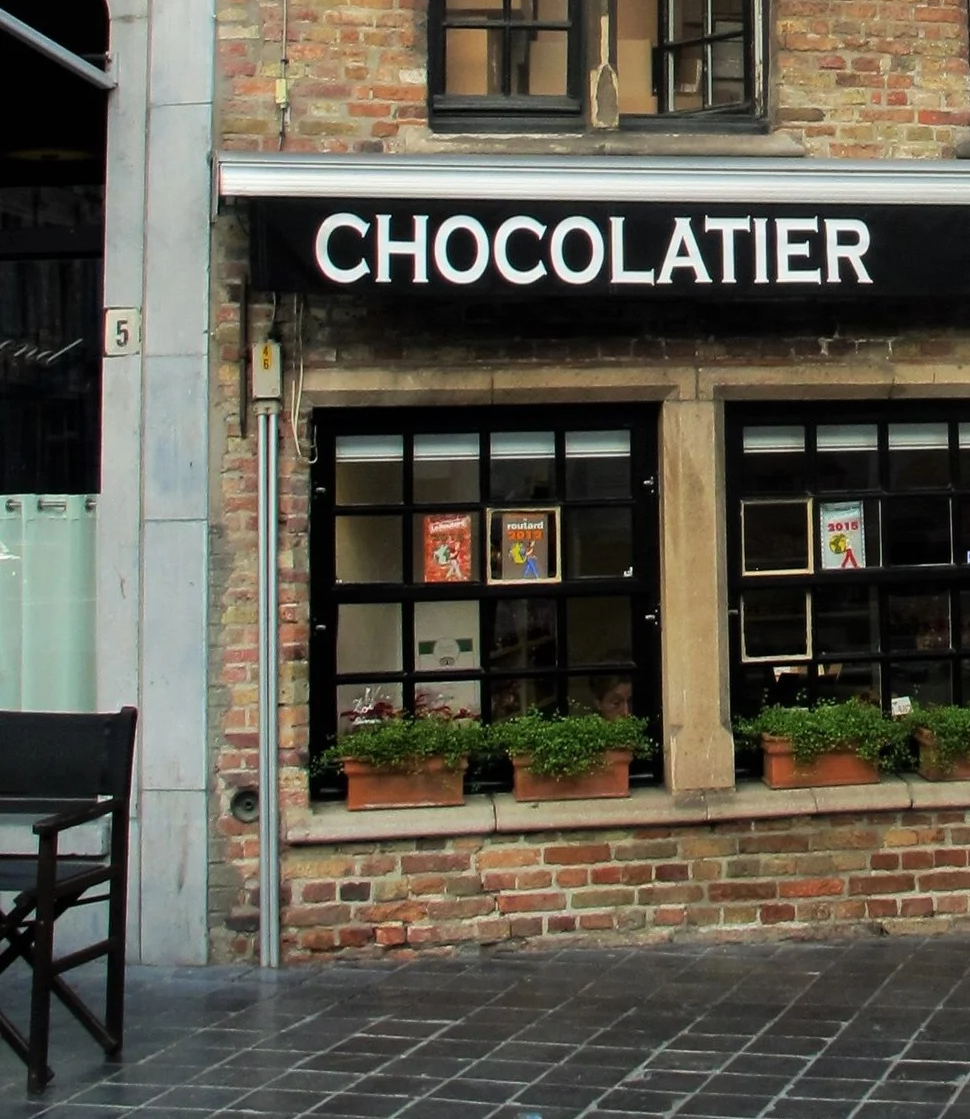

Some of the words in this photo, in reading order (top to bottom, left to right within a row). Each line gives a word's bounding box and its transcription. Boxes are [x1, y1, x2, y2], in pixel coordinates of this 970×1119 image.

[315, 212, 873, 286] CHOCOLATIER
[116, 319, 130, 347] 5
[506, 520, 544, 530] routard
[827, 521, 859, 532] 2015
